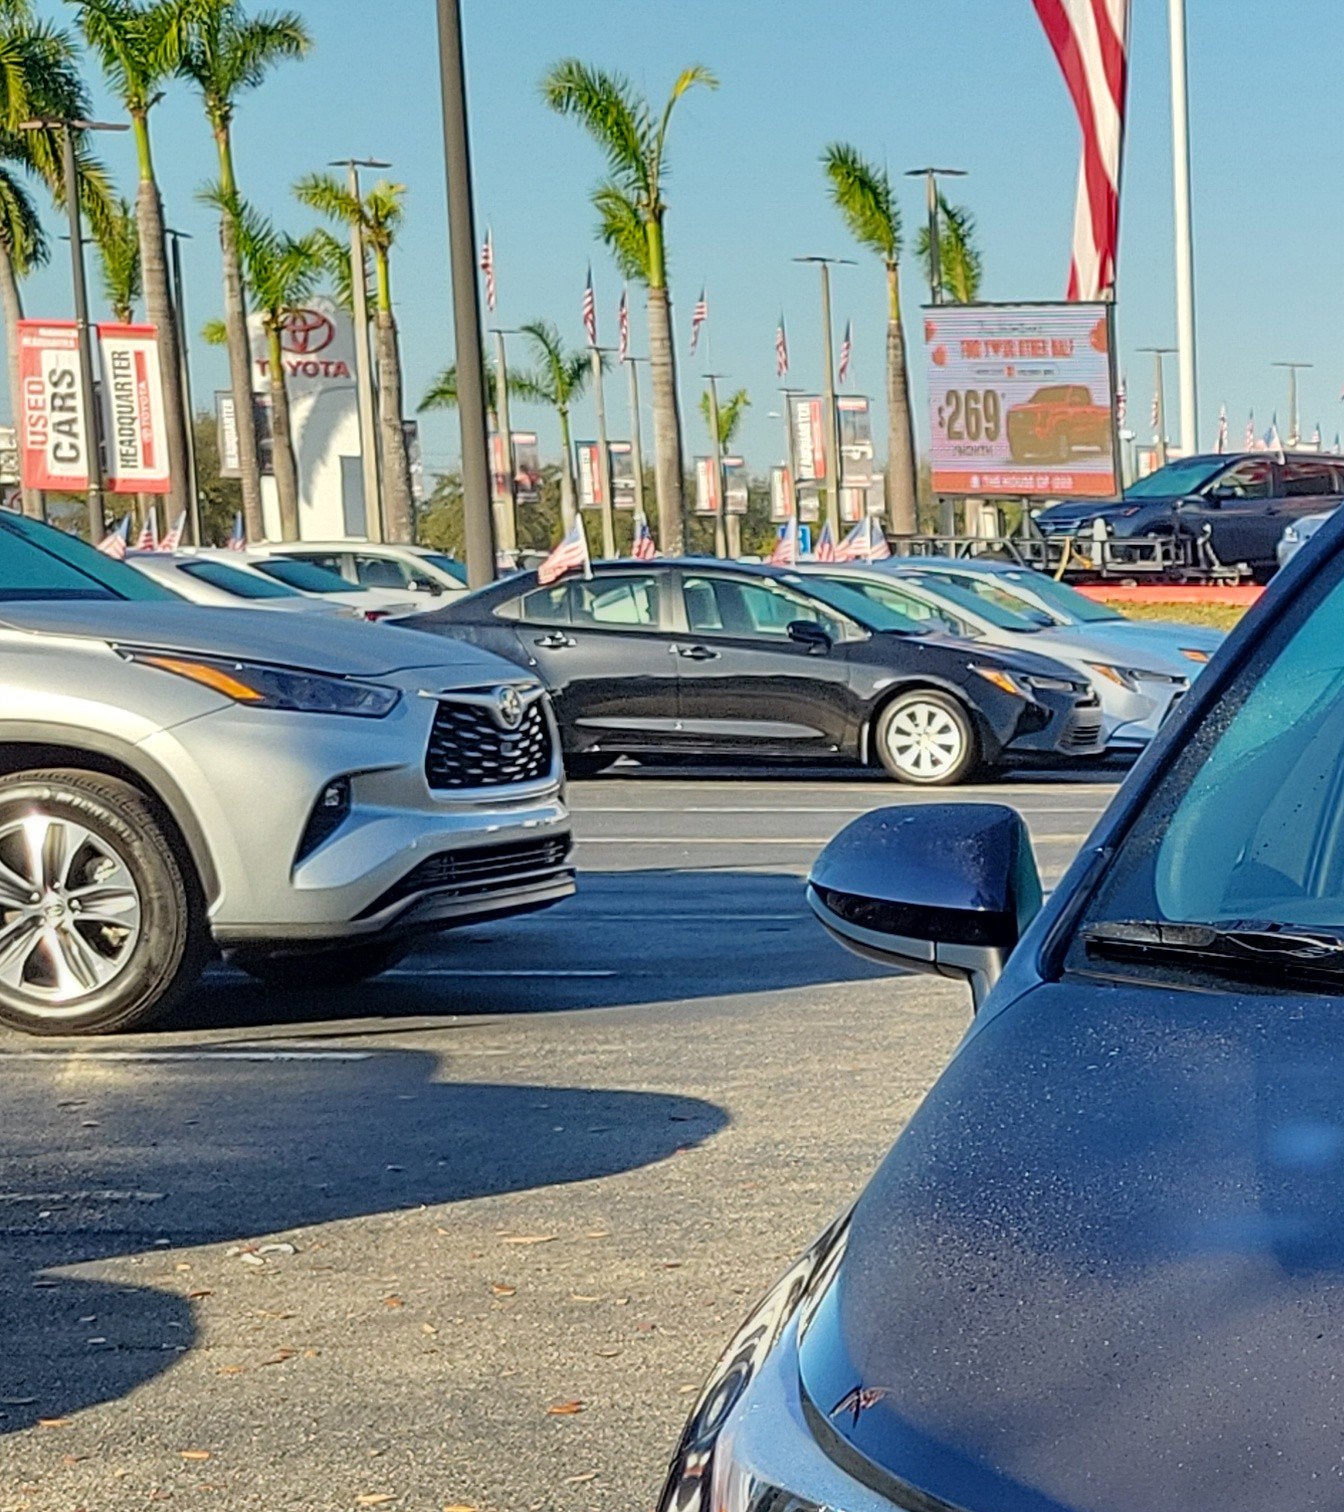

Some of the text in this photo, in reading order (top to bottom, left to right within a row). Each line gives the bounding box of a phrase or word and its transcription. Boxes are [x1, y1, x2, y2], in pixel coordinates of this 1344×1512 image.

[111, 350, 139, 469] HEADQUARTER
[255, 359, 350, 379] TYOTA
[27, 380, 49, 447] USED
[49, 368, 81, 464] CARS
